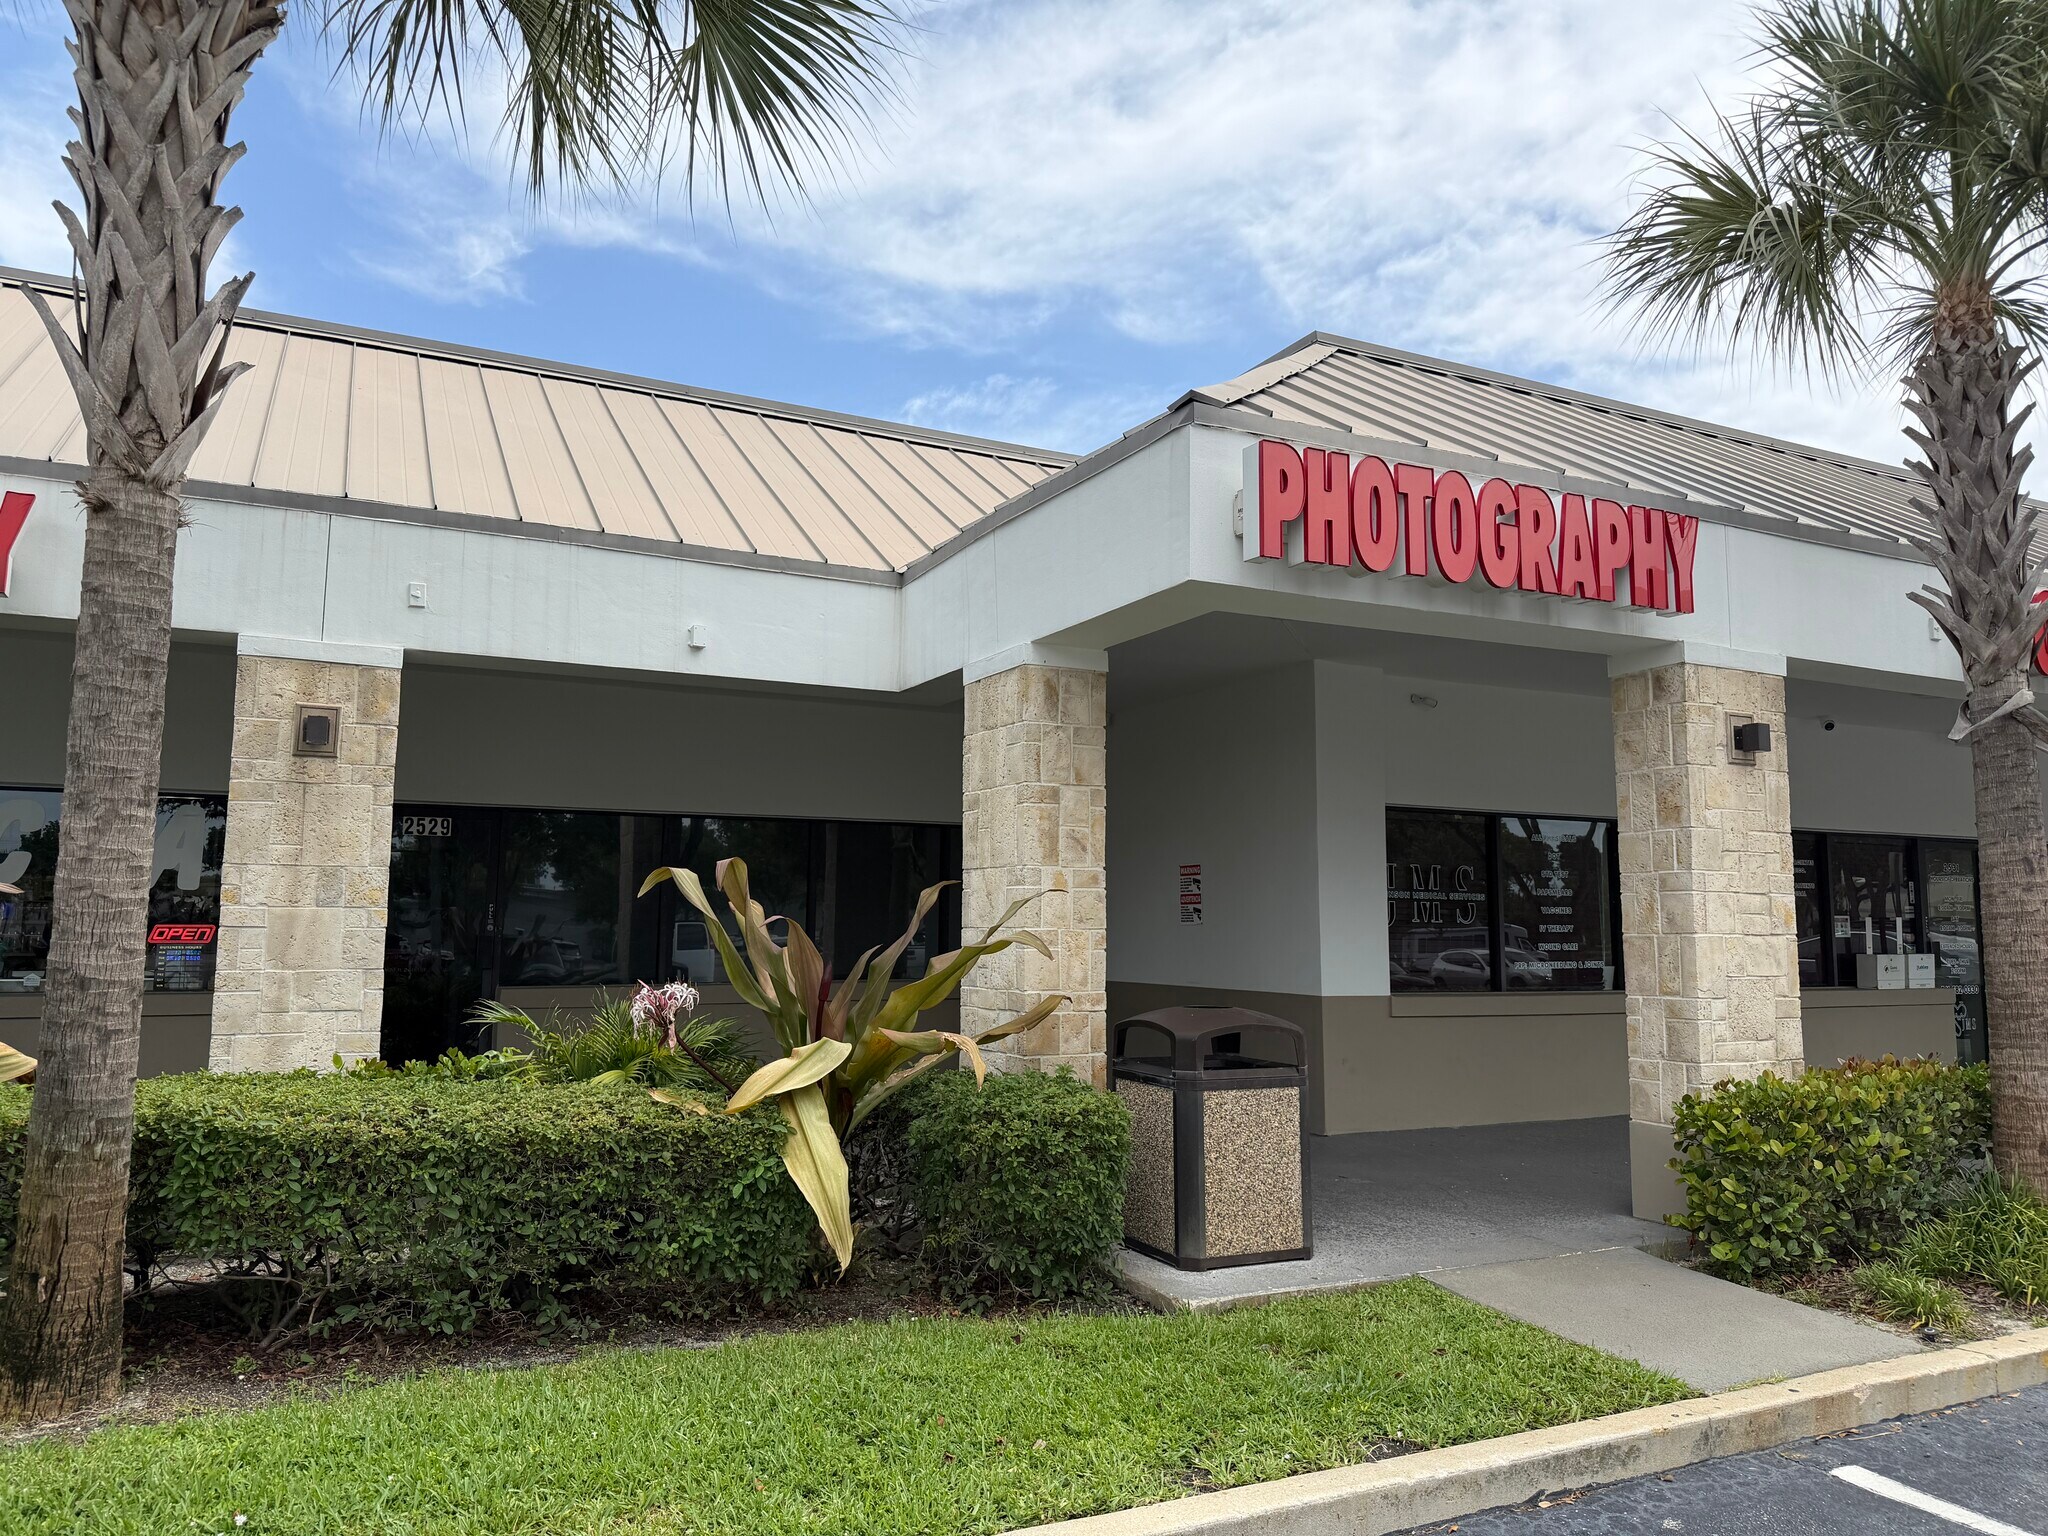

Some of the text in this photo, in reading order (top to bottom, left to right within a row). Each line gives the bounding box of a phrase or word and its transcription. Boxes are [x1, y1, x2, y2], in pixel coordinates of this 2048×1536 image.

[1257, 439, 1699, 614] PHOTOGRAPHY
[404, 817, 451, 836] 2529
[1531, 834, 1543, 842] ALL
[1553, 870, 1569, 878] TEST
[1387, 890, 1486, 901] NSON MEDICAL SERVICES
[1540, 906, 1572, 915] VACCINES
[1538, 925, 1574, 933] IV THERAPY
[152, 927, 212, 941] OPEN
[1537, 943, 1579, 951] WOUND CARE
[1528, 961, 1577, 969] MICRONEEDLING
[1584, 960, 1605, 969] JOINTS
